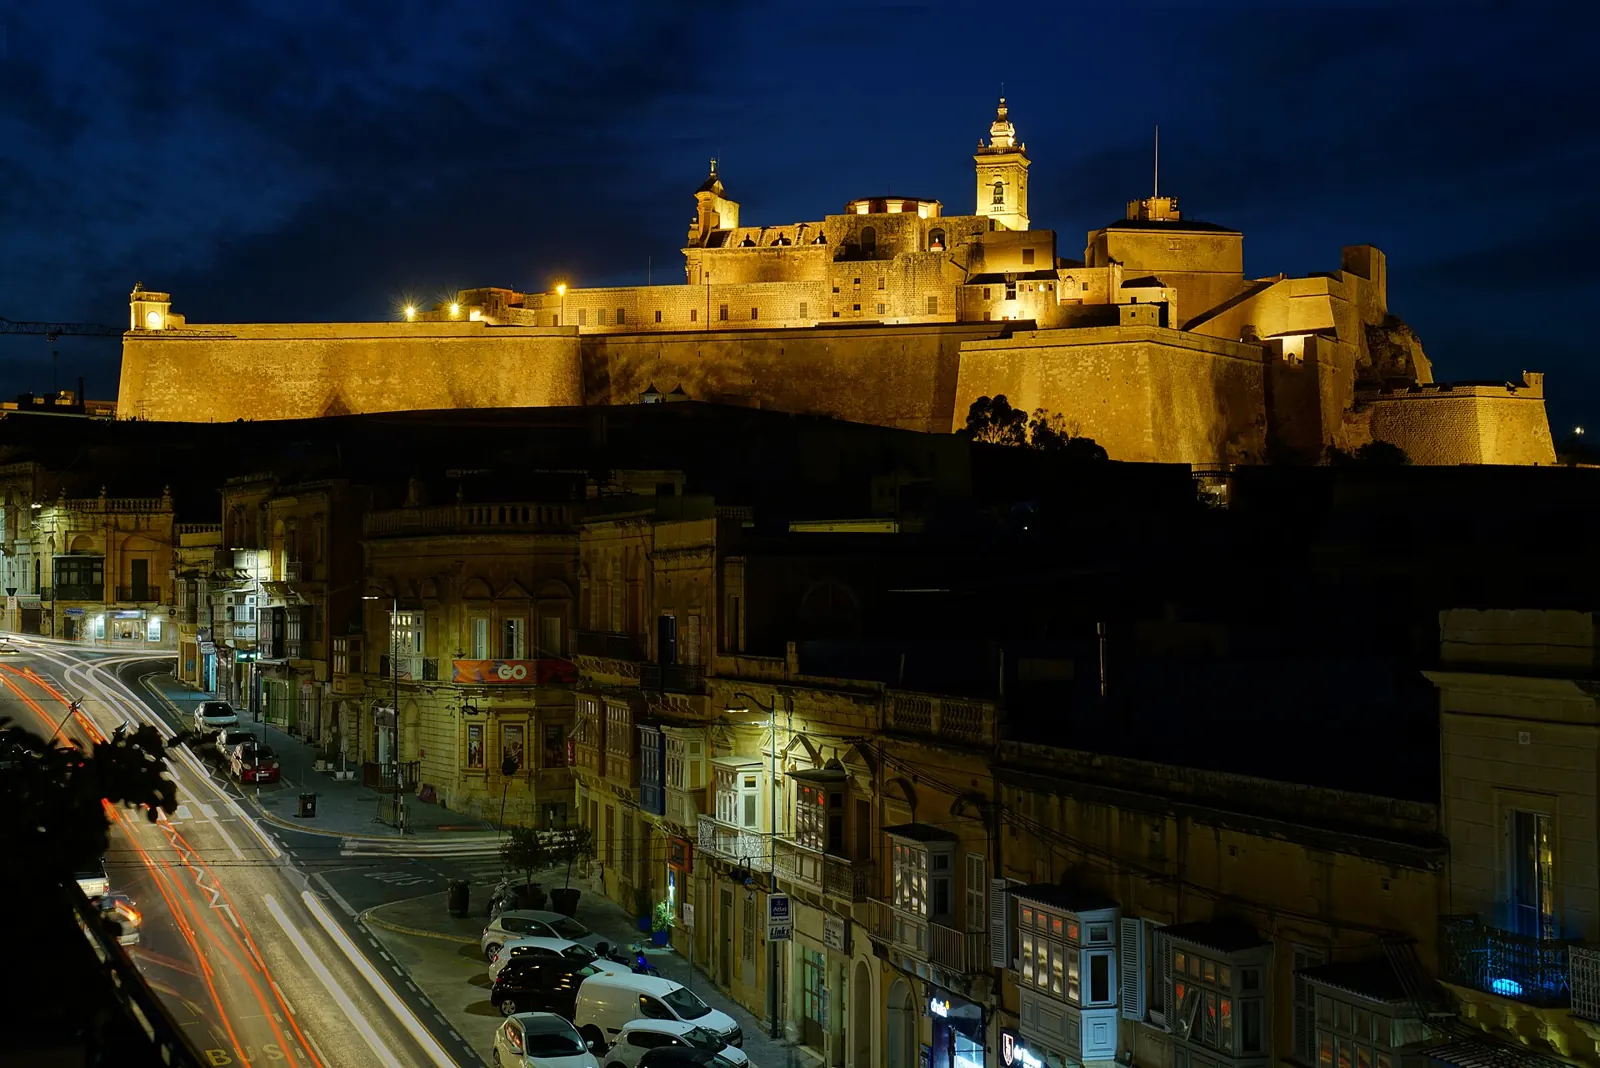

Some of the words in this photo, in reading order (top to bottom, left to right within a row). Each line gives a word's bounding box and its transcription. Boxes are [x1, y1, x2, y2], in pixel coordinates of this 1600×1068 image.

[498, 664, 527, 680] GO
[770, 926, 790, 936] Links
[204, 1044, 285, 1066] BUS
